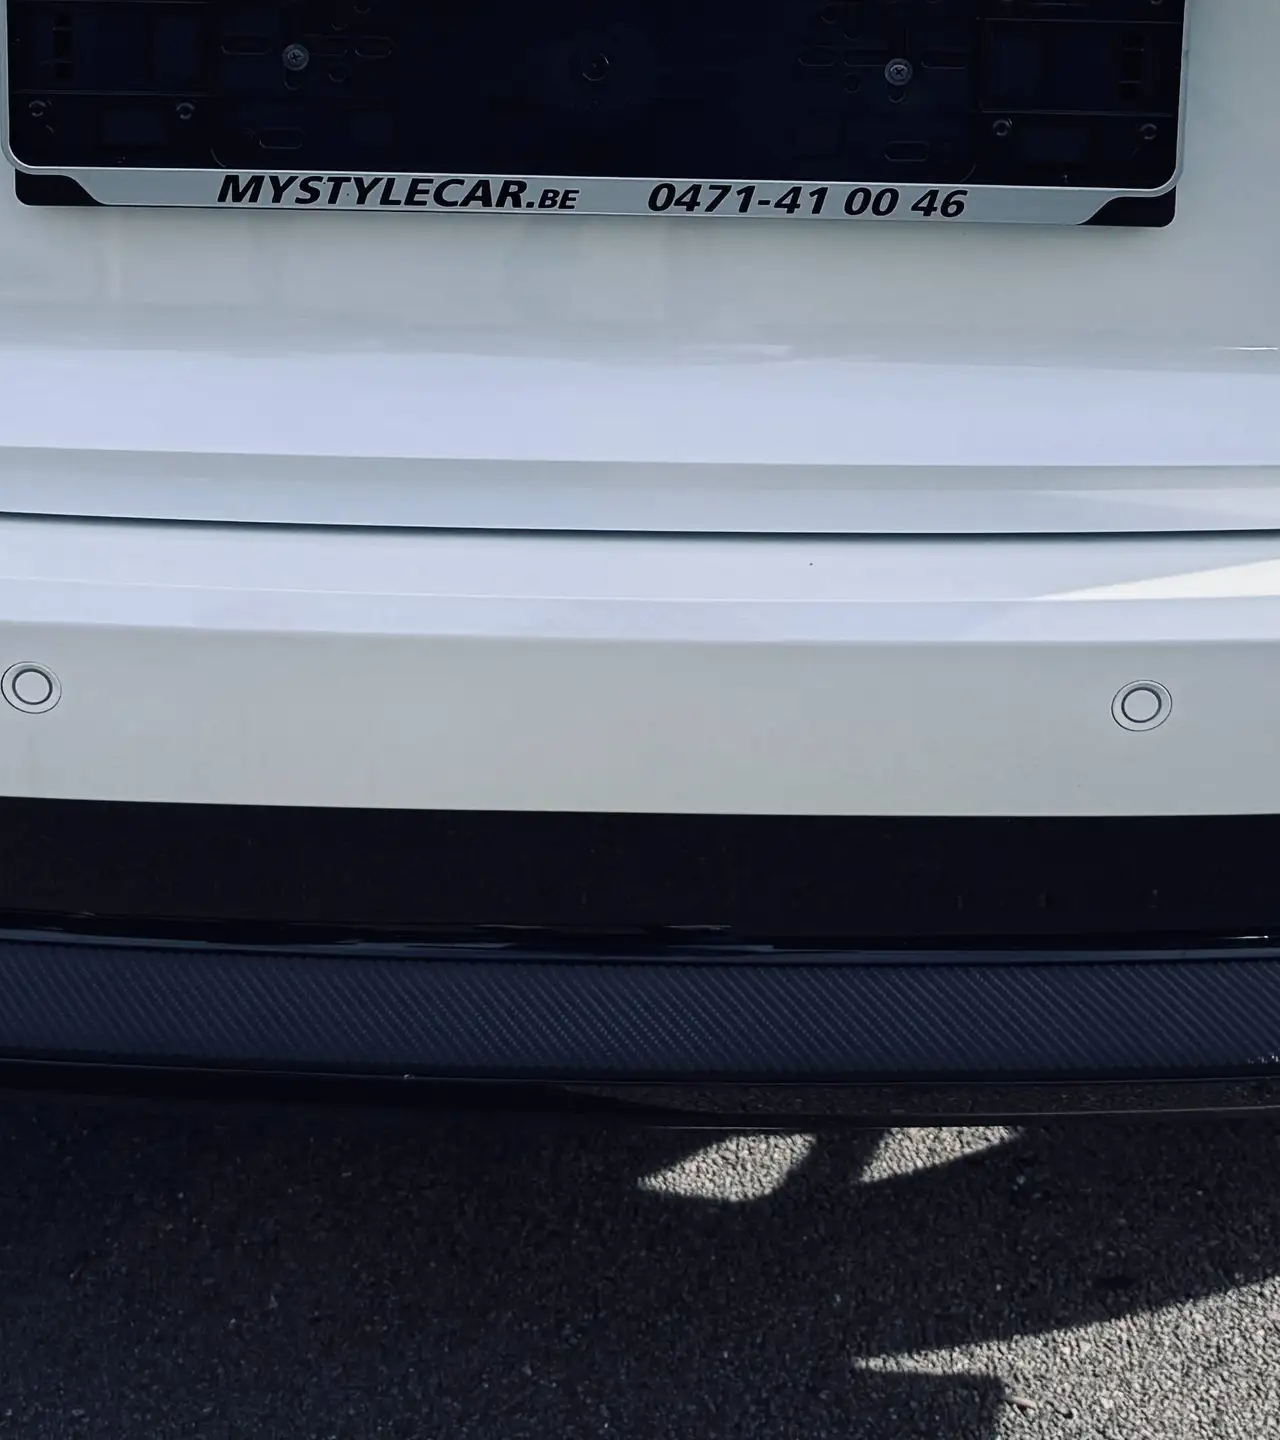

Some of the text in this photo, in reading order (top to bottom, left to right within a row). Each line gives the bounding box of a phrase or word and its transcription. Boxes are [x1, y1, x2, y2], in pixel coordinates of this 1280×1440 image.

[216, 174, 969, 218] MYSTYLECAR.BE 0471-41 00 46
